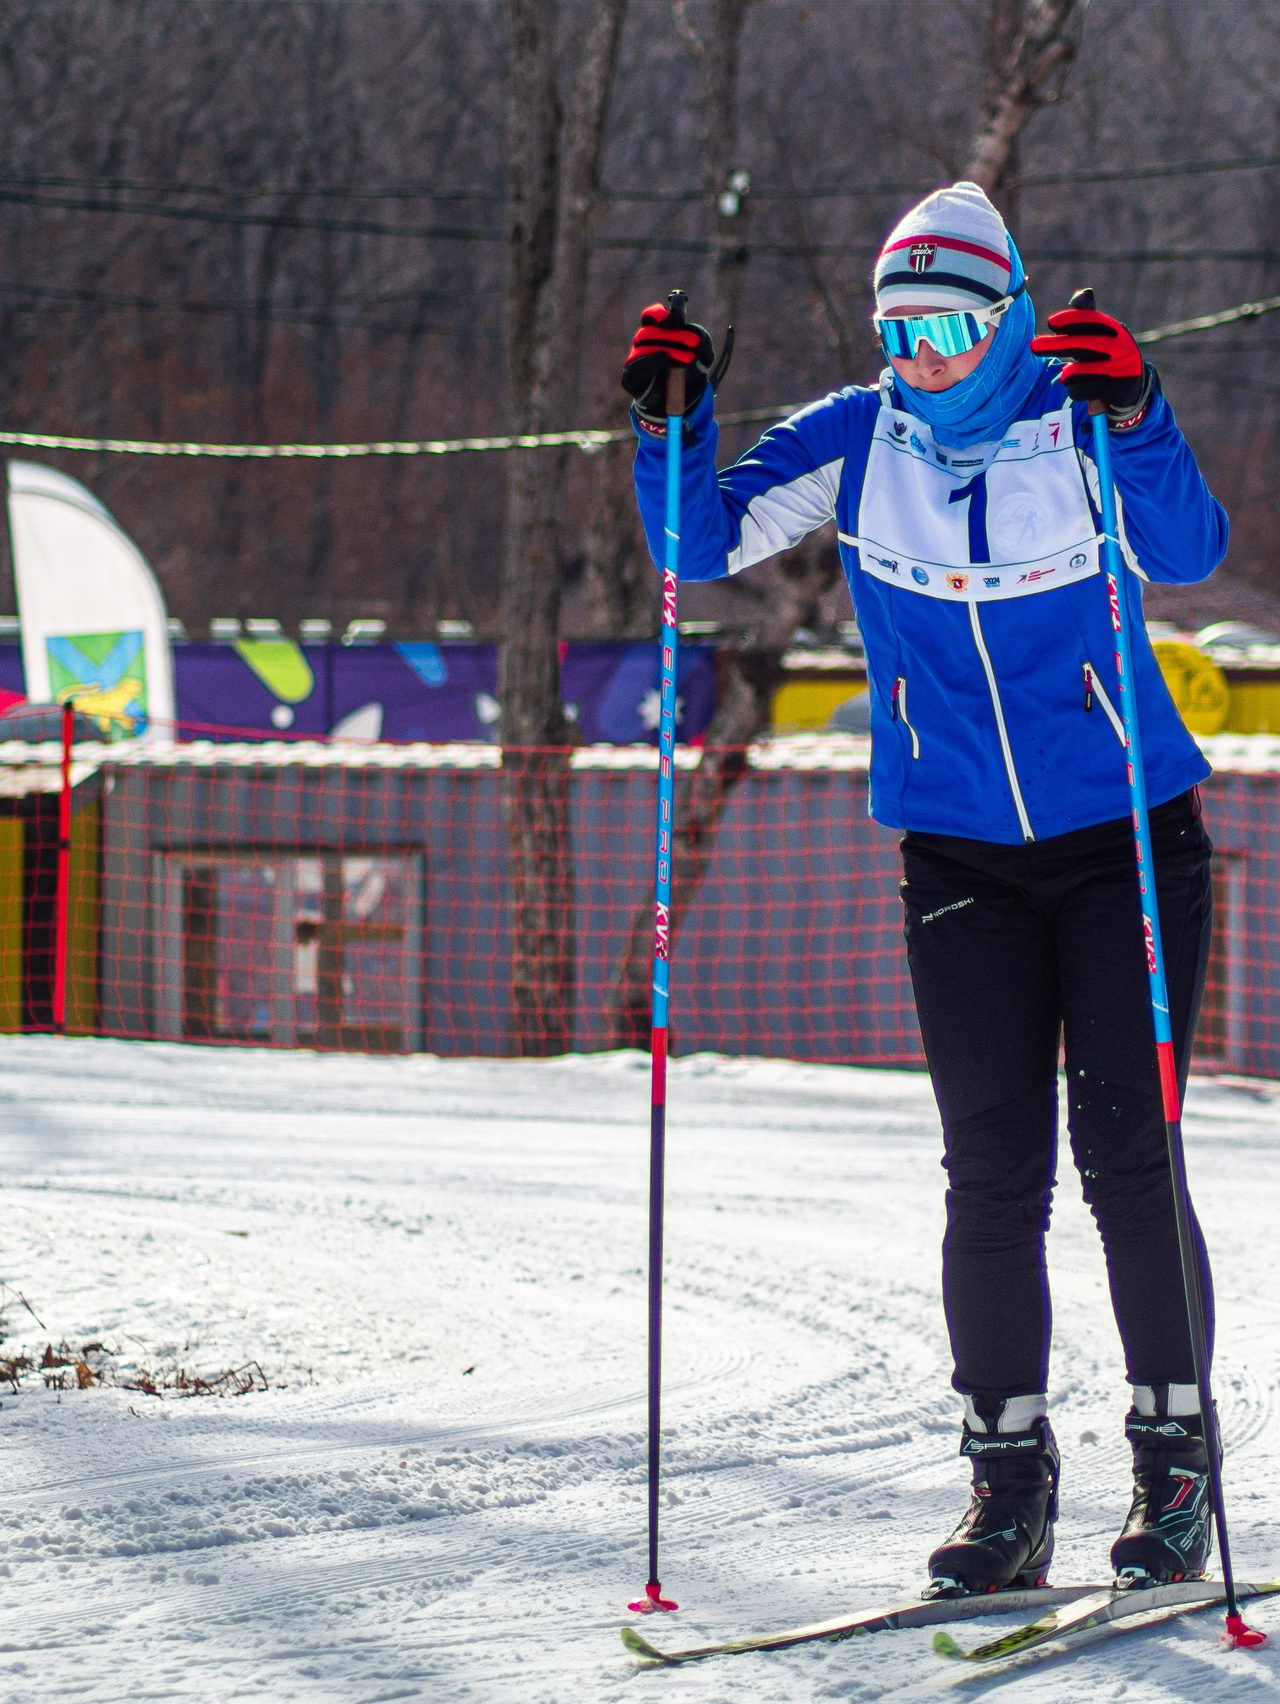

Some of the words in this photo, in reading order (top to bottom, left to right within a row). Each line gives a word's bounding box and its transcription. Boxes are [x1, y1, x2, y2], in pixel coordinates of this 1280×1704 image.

[948, 468, 991, 564] 1
[663, 567, 678, 627] KV+
[661, 645, 674, 779] ELITE
[658, 797, 670, 884] PRO
[933, 897, 974, 918] NORDSKI
[970, 1439, 1038, 1450] SPINE
